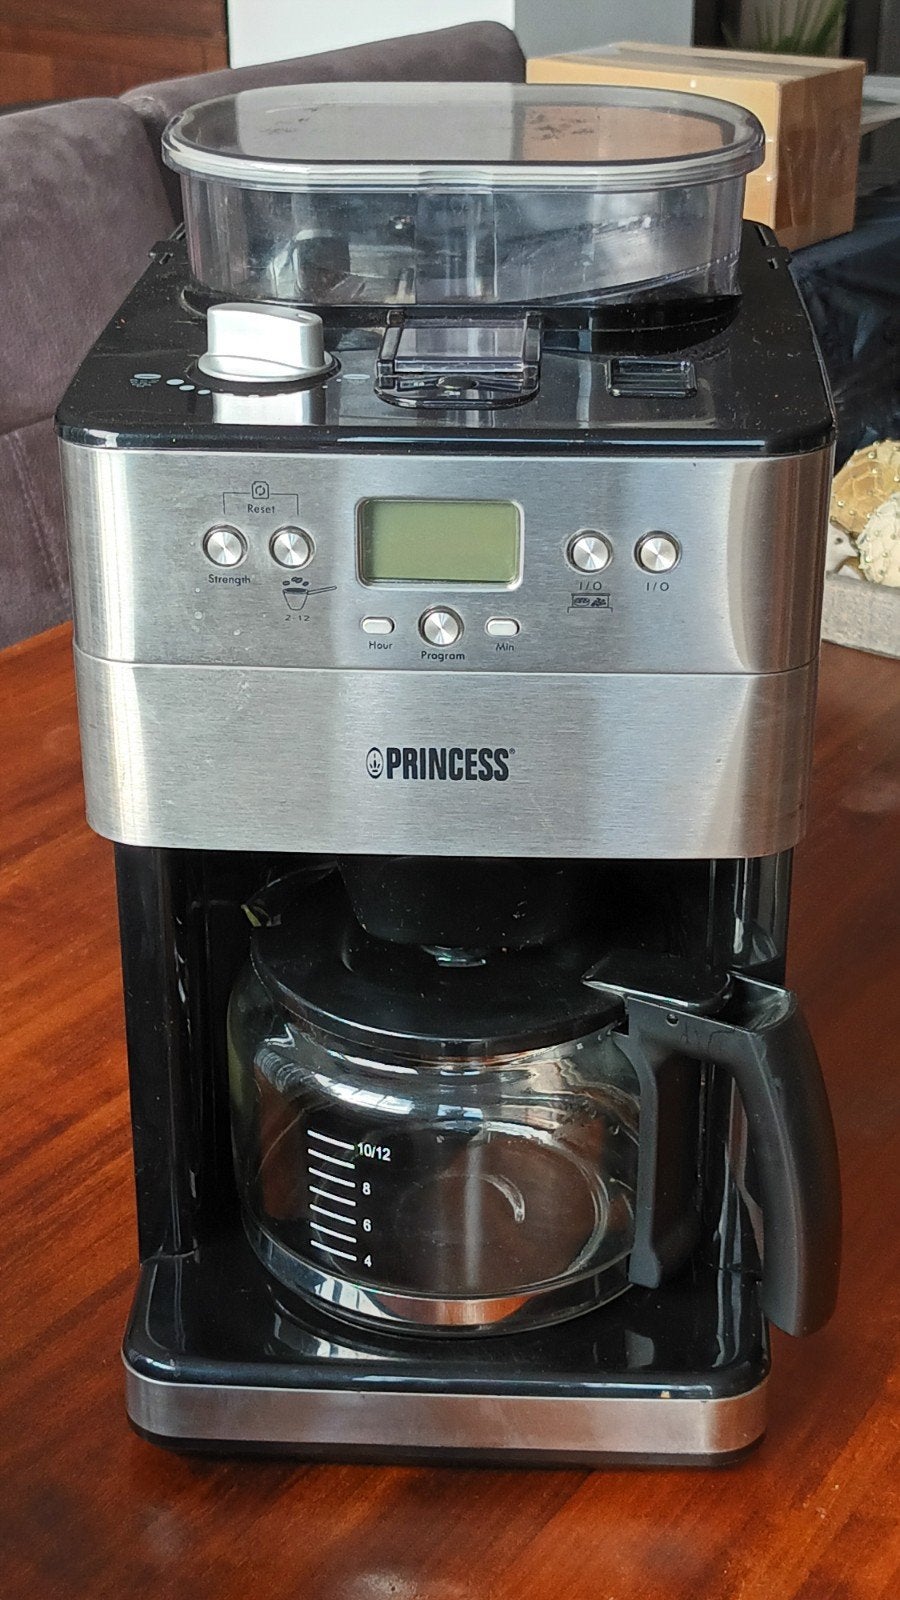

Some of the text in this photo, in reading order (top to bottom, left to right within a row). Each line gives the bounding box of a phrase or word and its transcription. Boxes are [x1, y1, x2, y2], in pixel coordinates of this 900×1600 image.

[247, 503, 276, 514] Reset
[208, 573, 251, 587] Strength
[368, 641, 393, 650] Hour
[495, 642, 515, 651] Min
[420, 650, 466, 663] Program
[386, 747, 510, 782] PRINCESS
[357, 1142, 392, 1162] 10/12
[362, 1181, 372, 1196] 8
[363, 1218, 372, 1232] 6
[363, 1254, 372, 1268] 4
